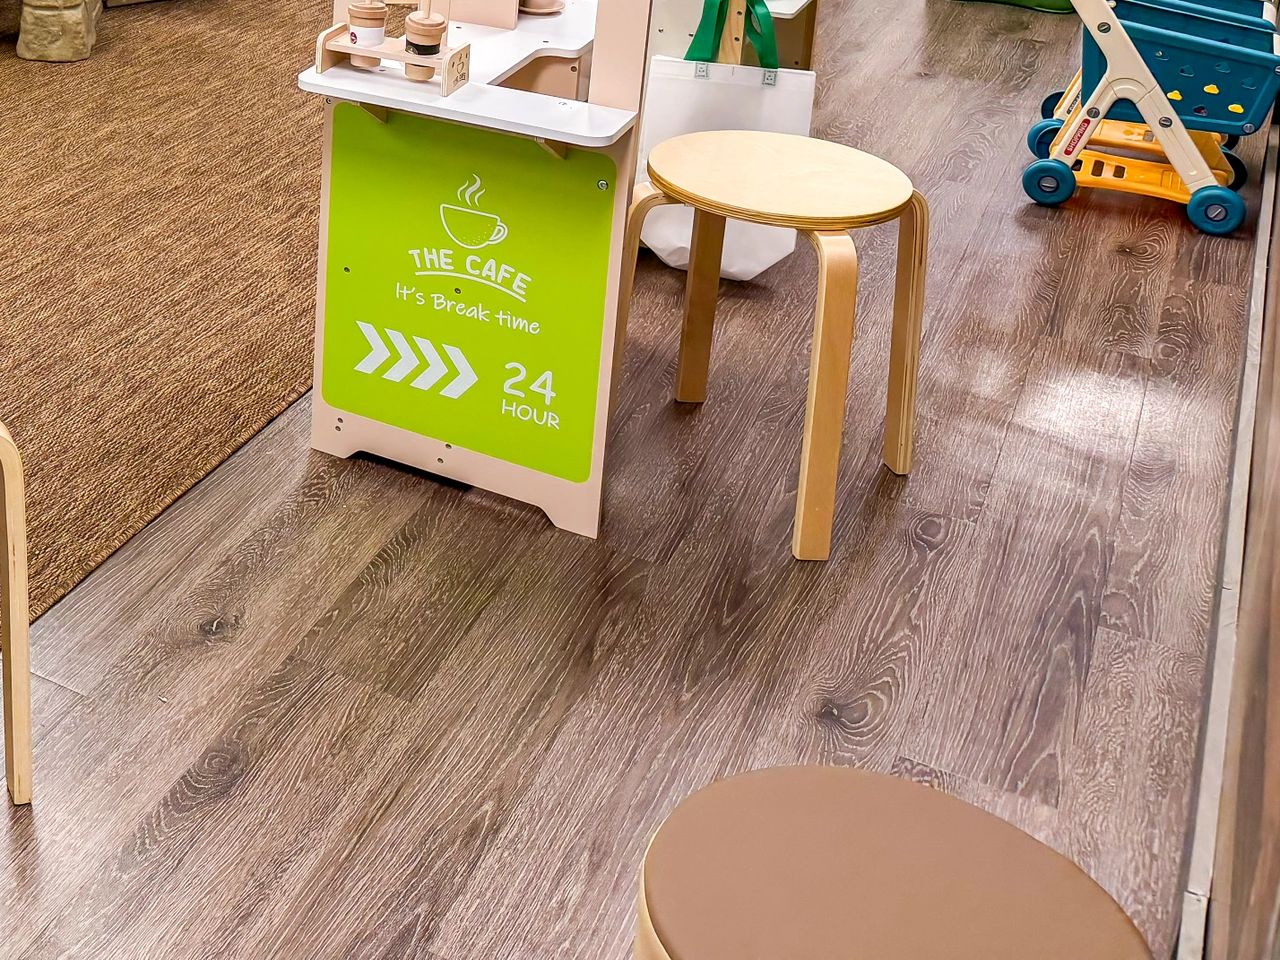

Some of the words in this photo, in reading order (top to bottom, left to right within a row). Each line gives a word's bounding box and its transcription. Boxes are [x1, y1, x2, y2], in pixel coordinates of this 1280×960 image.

[1068, 122, 1088, 151] SHOPPING
[408, 247, 454, 270] THE
[465, 254, 532, 296] CAFE
[395, 282, 425, 305] It's
[430, 293, 490, 322] Break
[494, 309, 541, 335] time
[503, 362, 557, 406] 24
[501, 399, 560, 430] HOUR
